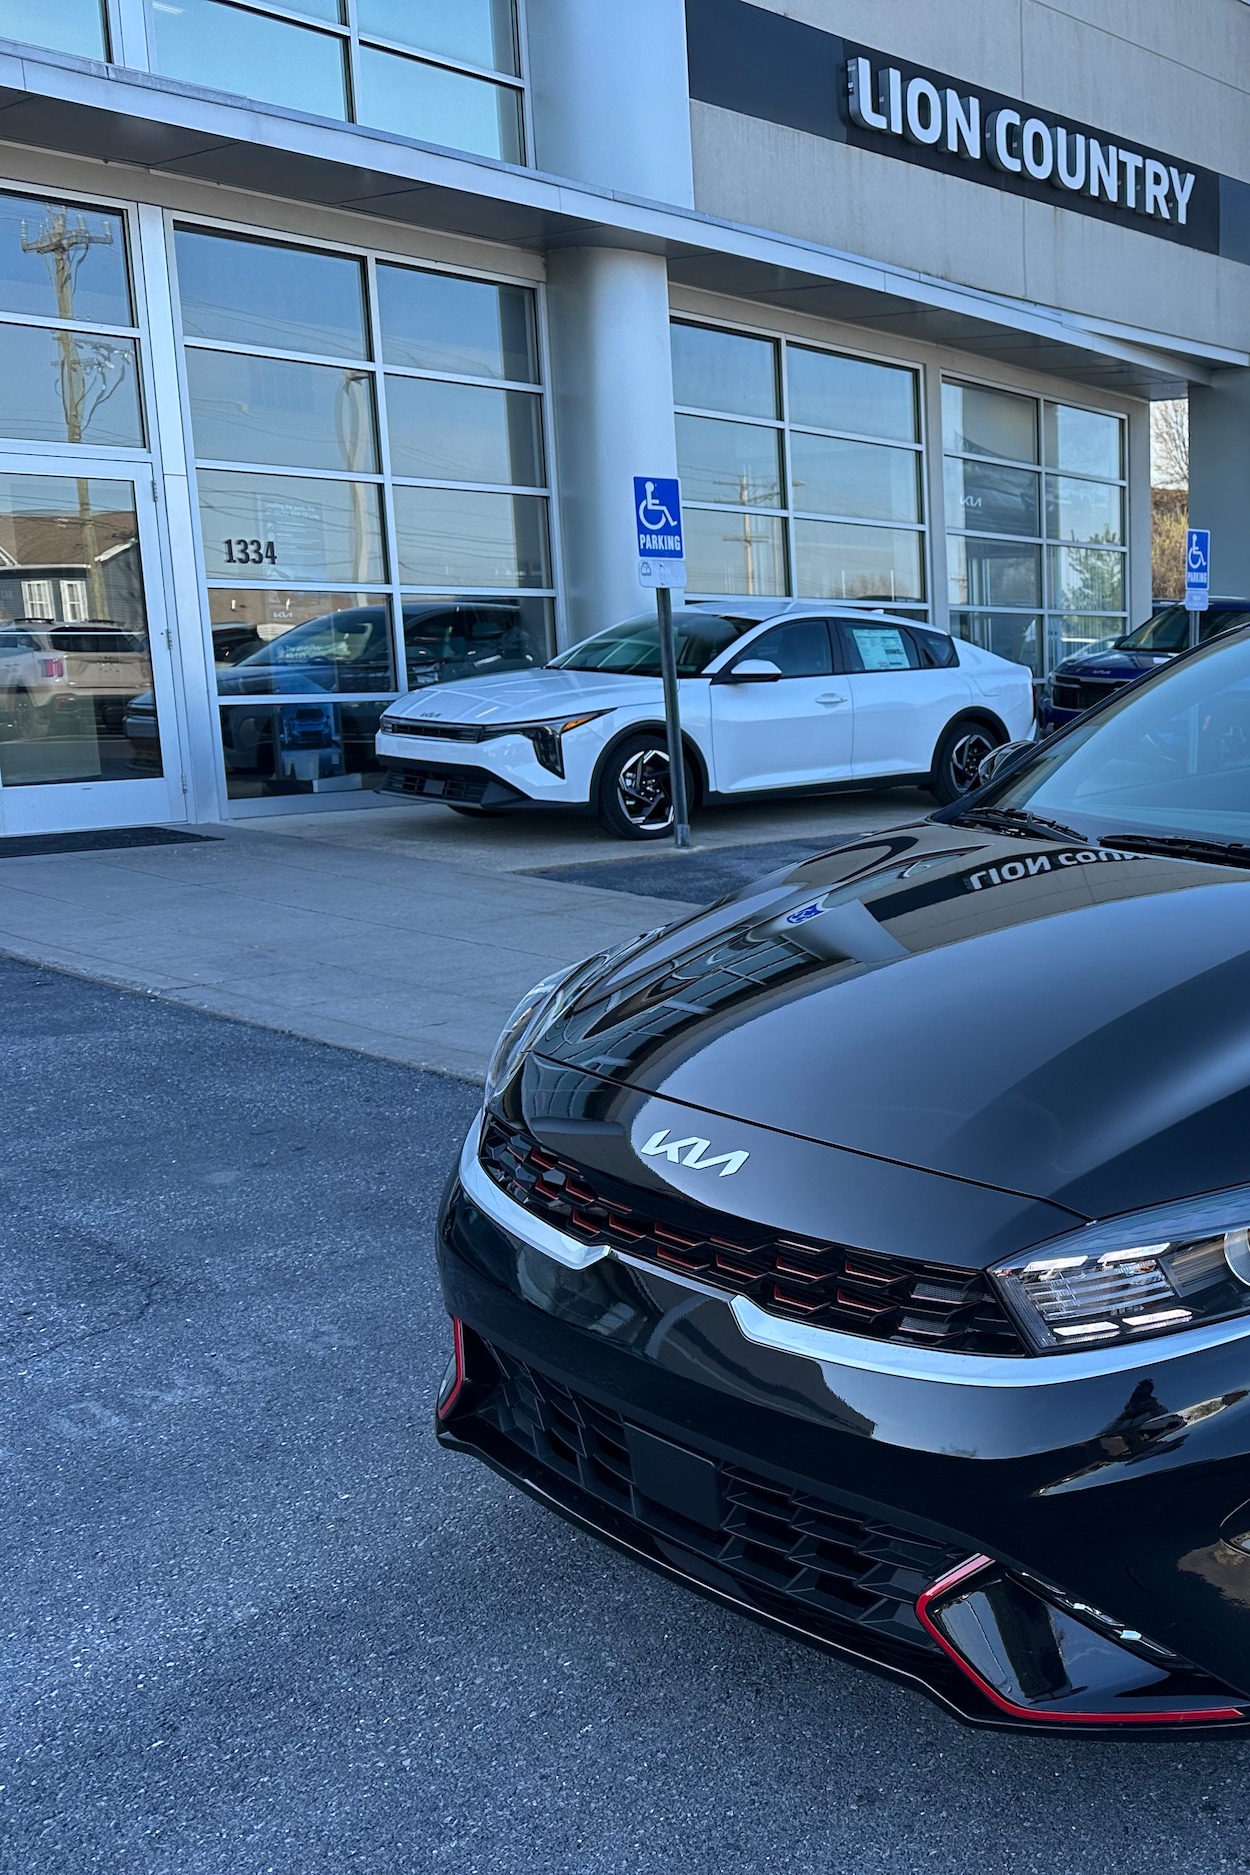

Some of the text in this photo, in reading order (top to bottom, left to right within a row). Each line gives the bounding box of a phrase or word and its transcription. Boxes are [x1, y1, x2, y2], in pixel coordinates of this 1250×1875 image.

[849, 56, 1197, 225] LION COUNTRY
[223, 538, 278, 565] 1334
[640, 533, 681, 551] PARKING
[640, 1128, 750, 1177] KIA
